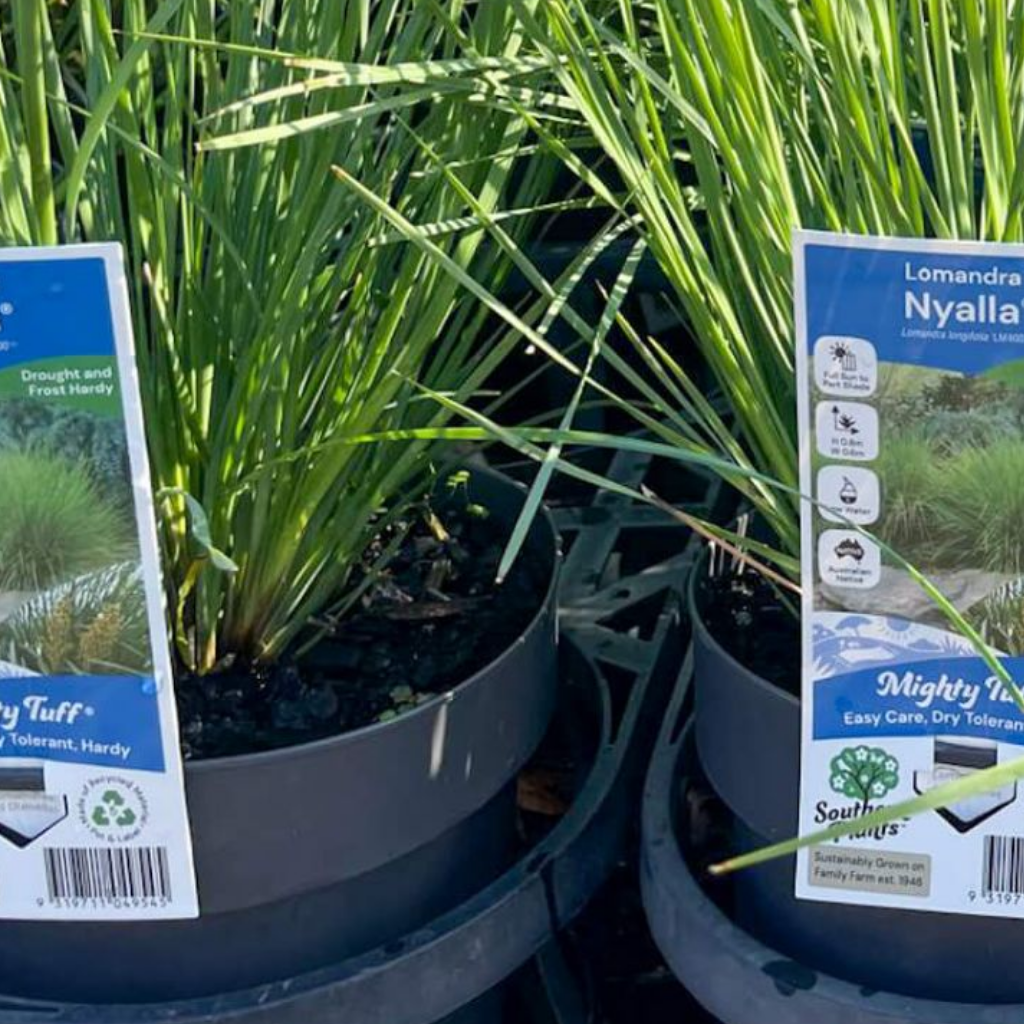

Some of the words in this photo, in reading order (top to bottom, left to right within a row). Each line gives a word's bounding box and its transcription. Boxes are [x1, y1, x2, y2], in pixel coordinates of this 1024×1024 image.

[904, 261, 1021, 286] Lomandra
[21, 368, 81, 384] Drought
[84, 366, 112, 379] and
[28, 383, 66, 396] Frost
[68, 381, 113, 396] Hardy
[876, 671, 980, 709] Mighty
[844, 711, 881, 728] Easy
[884, 710, 928, 726] Care,
[932, 710, 960, 727] Dry
[9, 733, 79, 752] Tolerant,
[81, 739, 132, 759] Hardy
[814, 796, 906, 824] South
[814, 851, 873, 869] Sustainably
[875, 857, 910, 871] Grown
[911, 863, 925, 872] on
[814, 867, 847, 883] Family
[850, 870, 876, 883] Farm
[967, 890, 977, 902] 9
